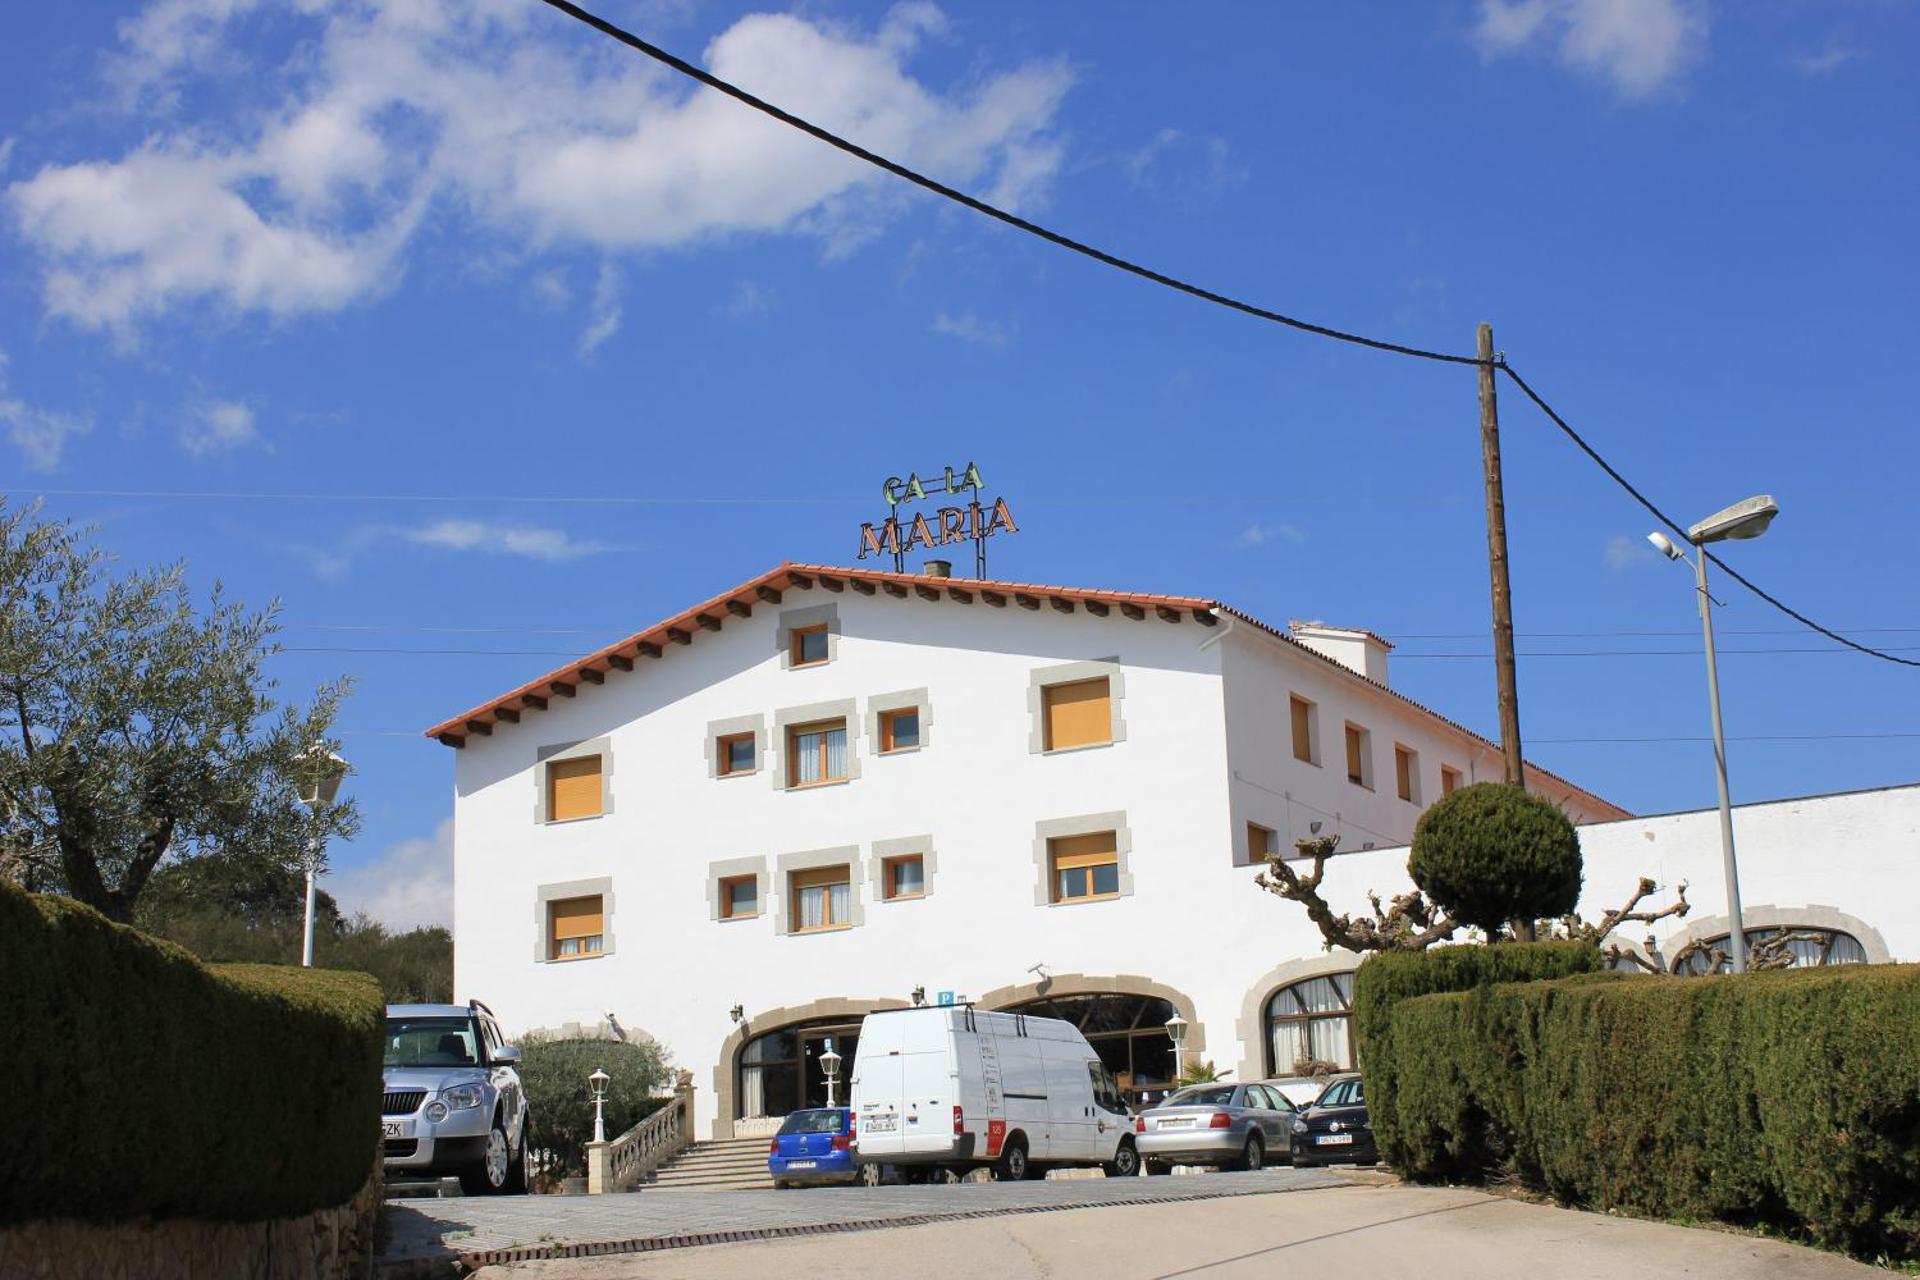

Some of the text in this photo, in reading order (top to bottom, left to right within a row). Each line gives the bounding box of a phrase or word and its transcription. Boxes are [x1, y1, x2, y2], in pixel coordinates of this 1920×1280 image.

[883, 461, 986, 505] CA LA
[857, 496, 1020, 560] MARIA
